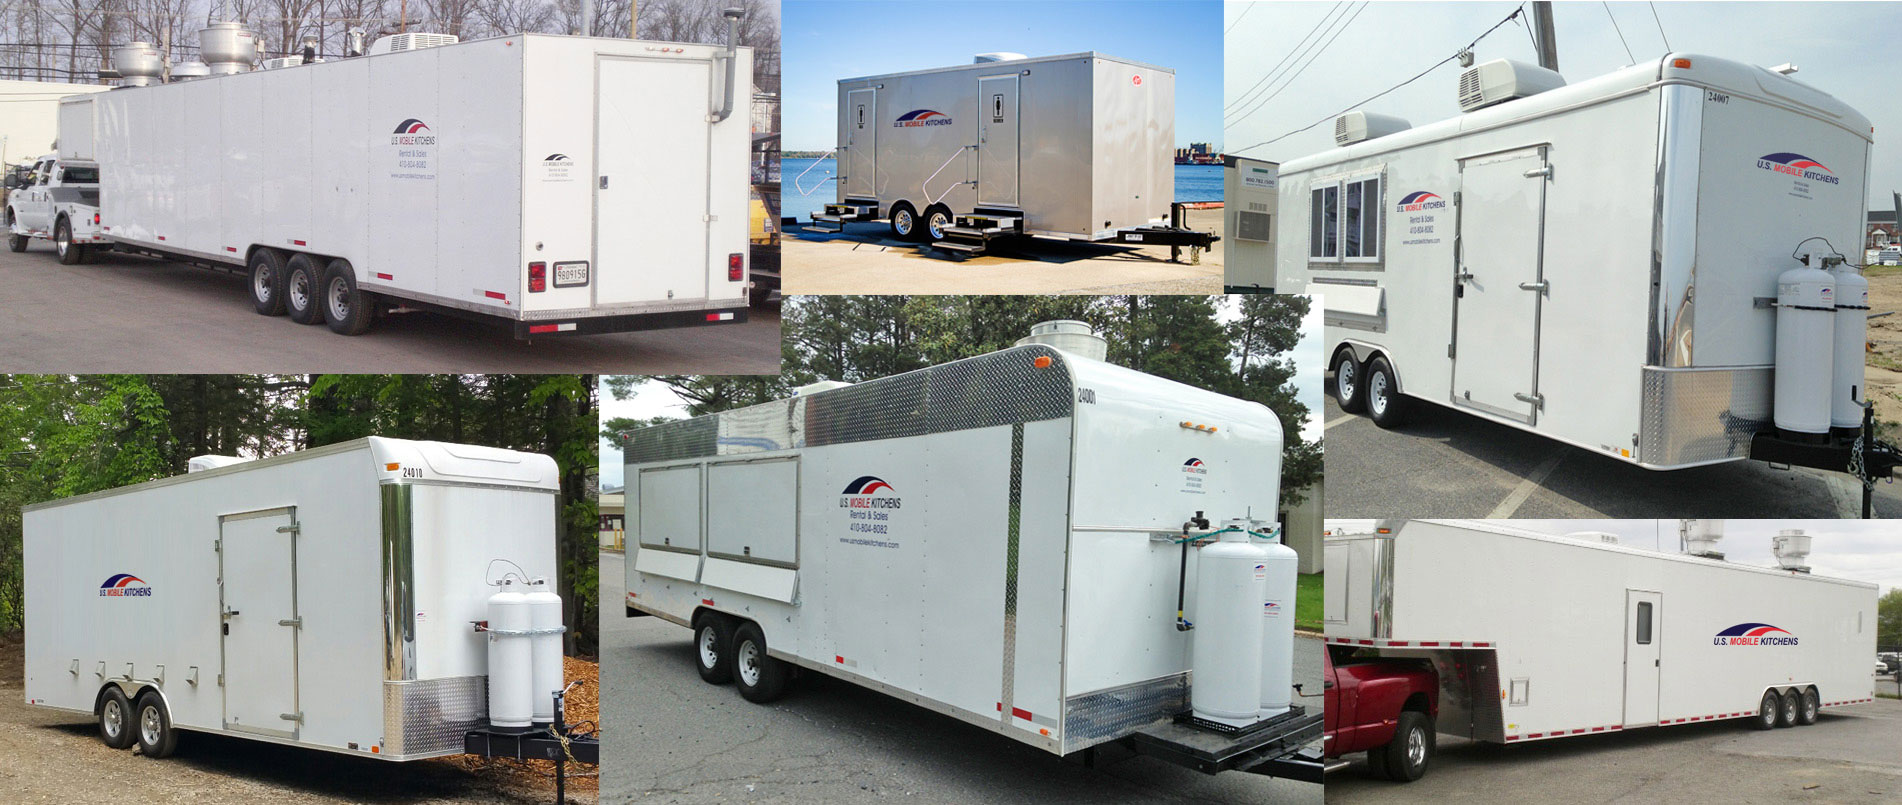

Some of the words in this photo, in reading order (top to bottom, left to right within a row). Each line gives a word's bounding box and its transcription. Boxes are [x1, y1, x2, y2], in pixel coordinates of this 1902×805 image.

[1708, 91, 1729, 104] 24007
[925, 118, 952, 126] KITCHENS
[399, 136, 414, 145] MOBILE
[414, 136, 435, 145] KITCHENS
[1757, 159, 1772, 170] U.S.
[1773, 163, 1804, 177] MOBILE
[1803, 170, 1839, 184] KITCHENS
[1405, 203, 1423, 211] MOBILE
[1422, 200, 1445, 210] KITCHENS
[1078, 387, 1096, 404] 24001
[403, 467, 422, 478] 24010
[840, 497, 849, 507] U.S.
[849, 497, 872, 508] MOBILE
[871, 497, 901, 508] KITCHENS
[850, 509, 866, 519] Rental
[867, 510, 872, 519] &
[873, 511, 888, 520] Sales
[850, 522, 887, 534] 410-804-8082
[106, 588, 125, 596] MOBILE
[124, 586, 152, 596] KITCHENS
[1713, 637, 1728, 645] U.S.
[1729, 637, 1760, 645] MOBILE
[1760, 637, 1798, 645] KITCHENS
